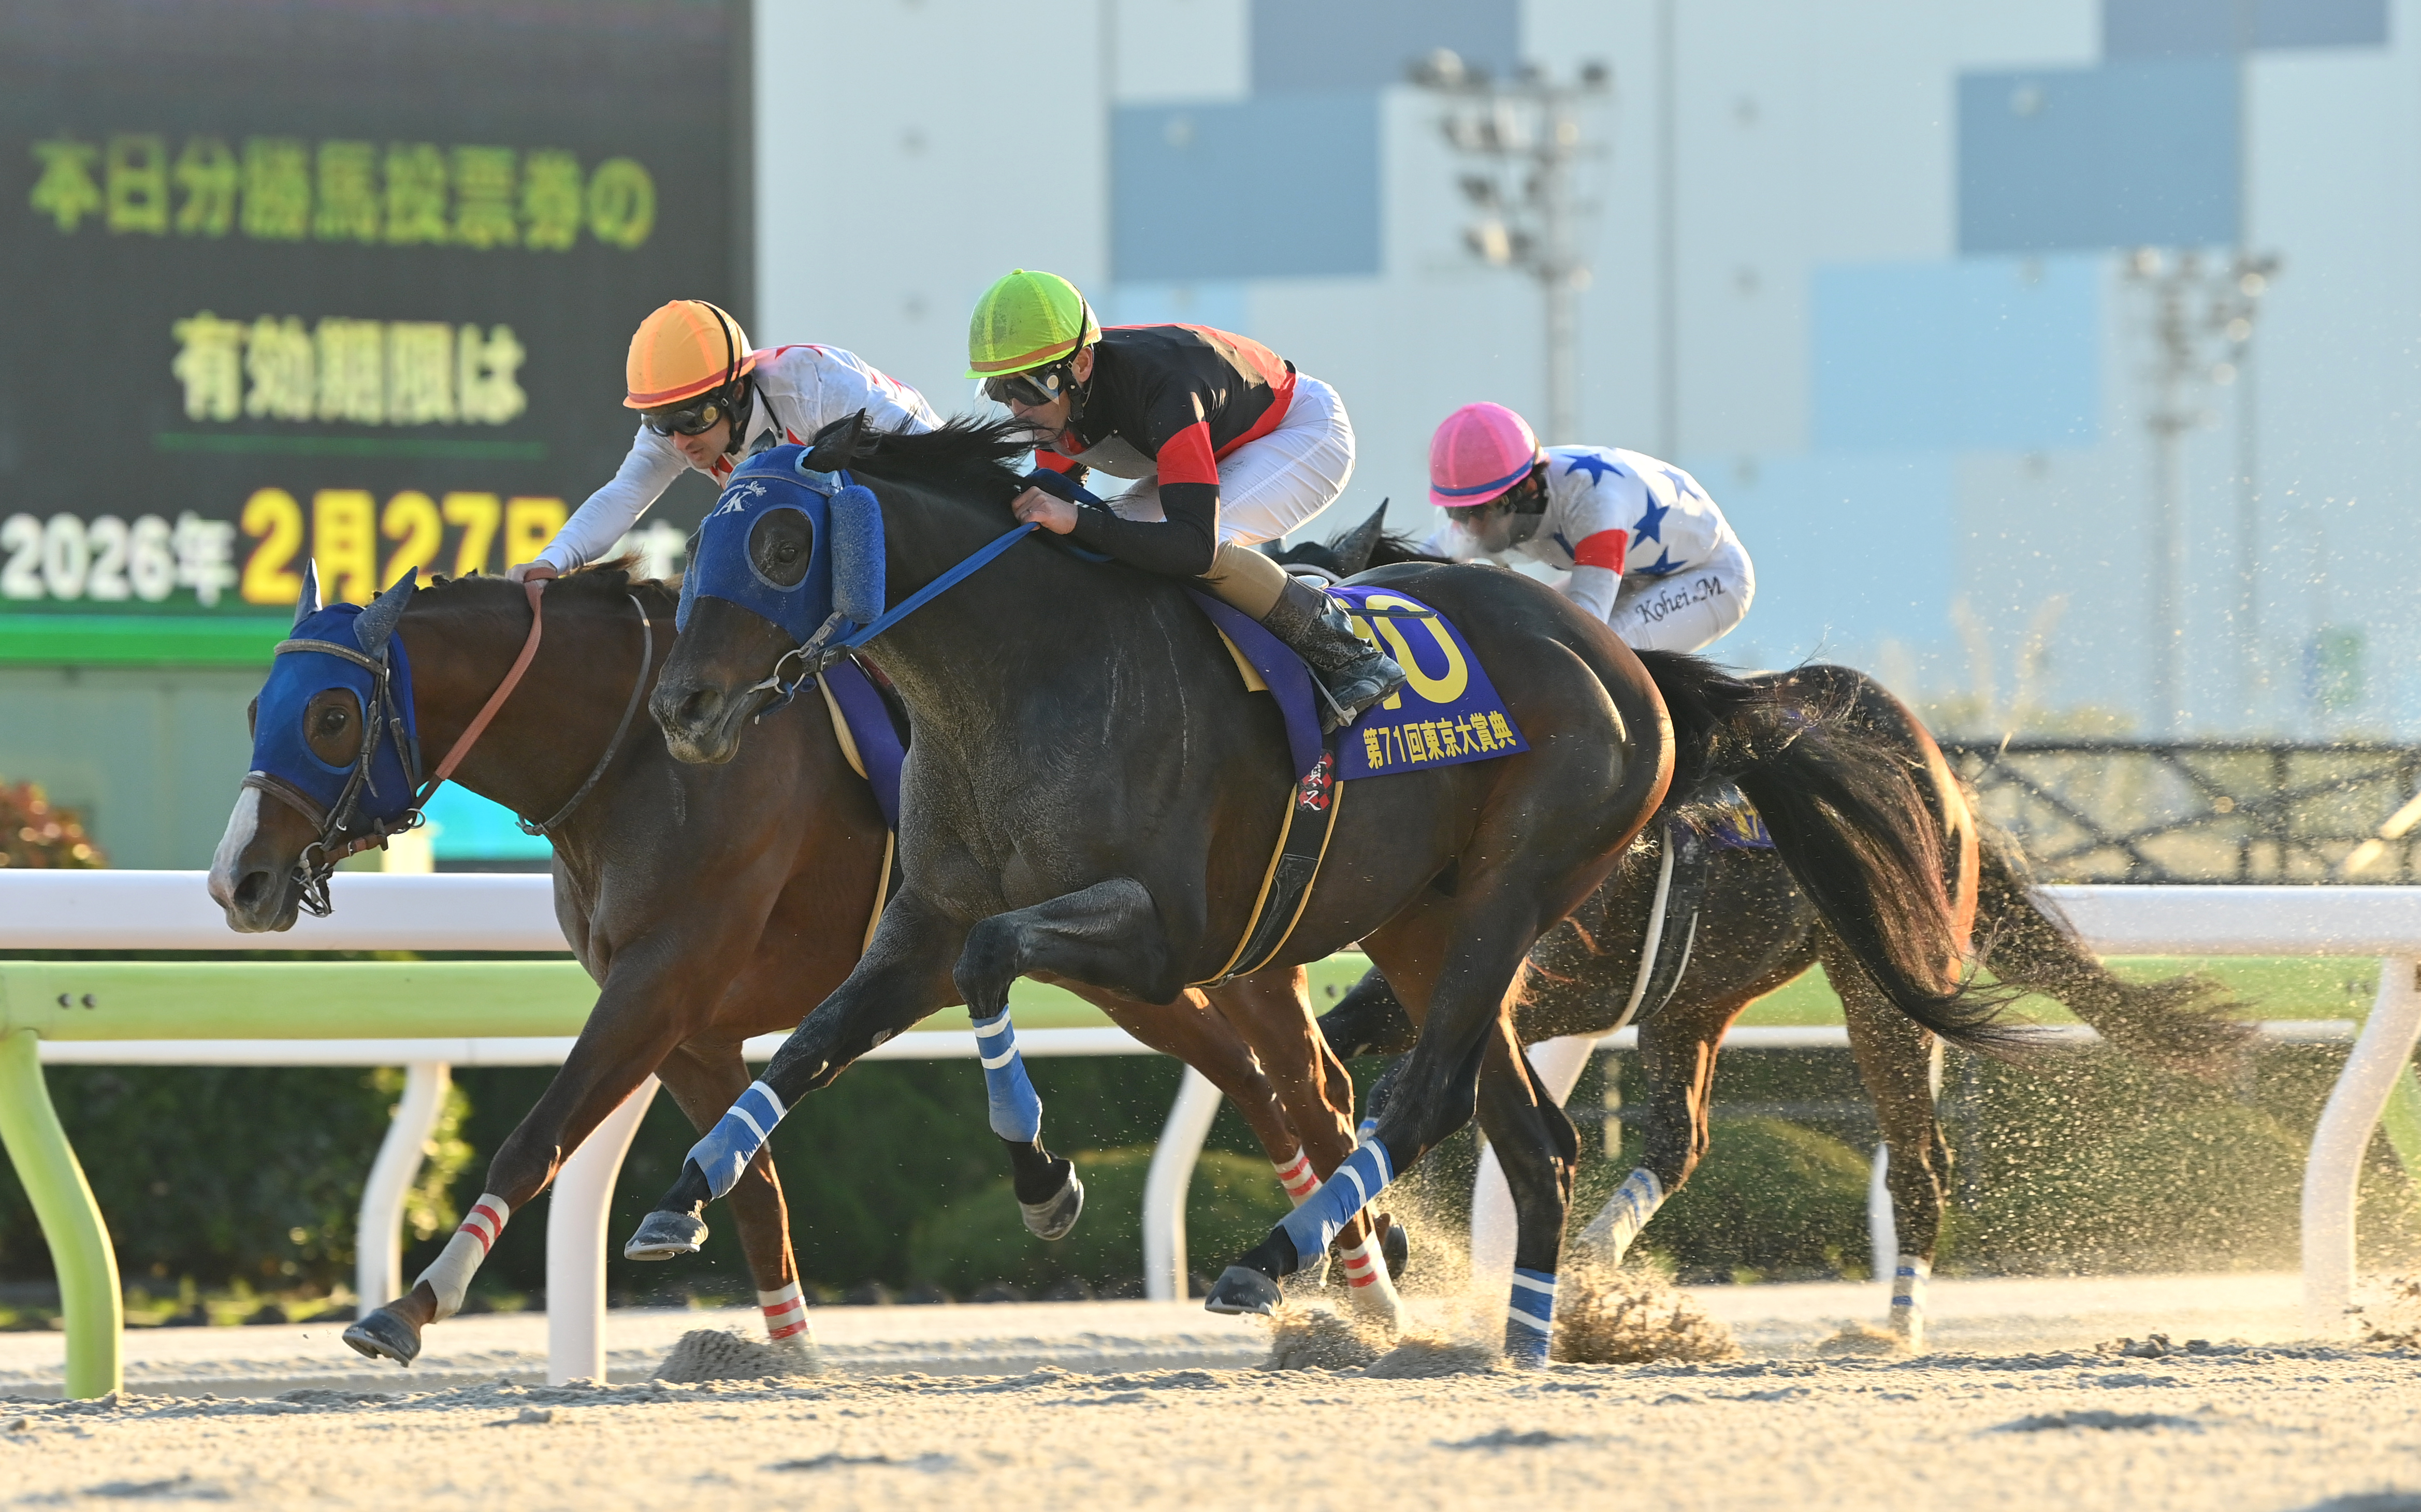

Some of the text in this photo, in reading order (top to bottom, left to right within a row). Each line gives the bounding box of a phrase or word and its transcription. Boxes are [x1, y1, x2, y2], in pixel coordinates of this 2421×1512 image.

[30, 132, 657, 252] 本日分勝馬投票券の
[172, 311, 527, 425] 有効期限は
[1362, 710, 1517, 770] 第71回東京大賞典
